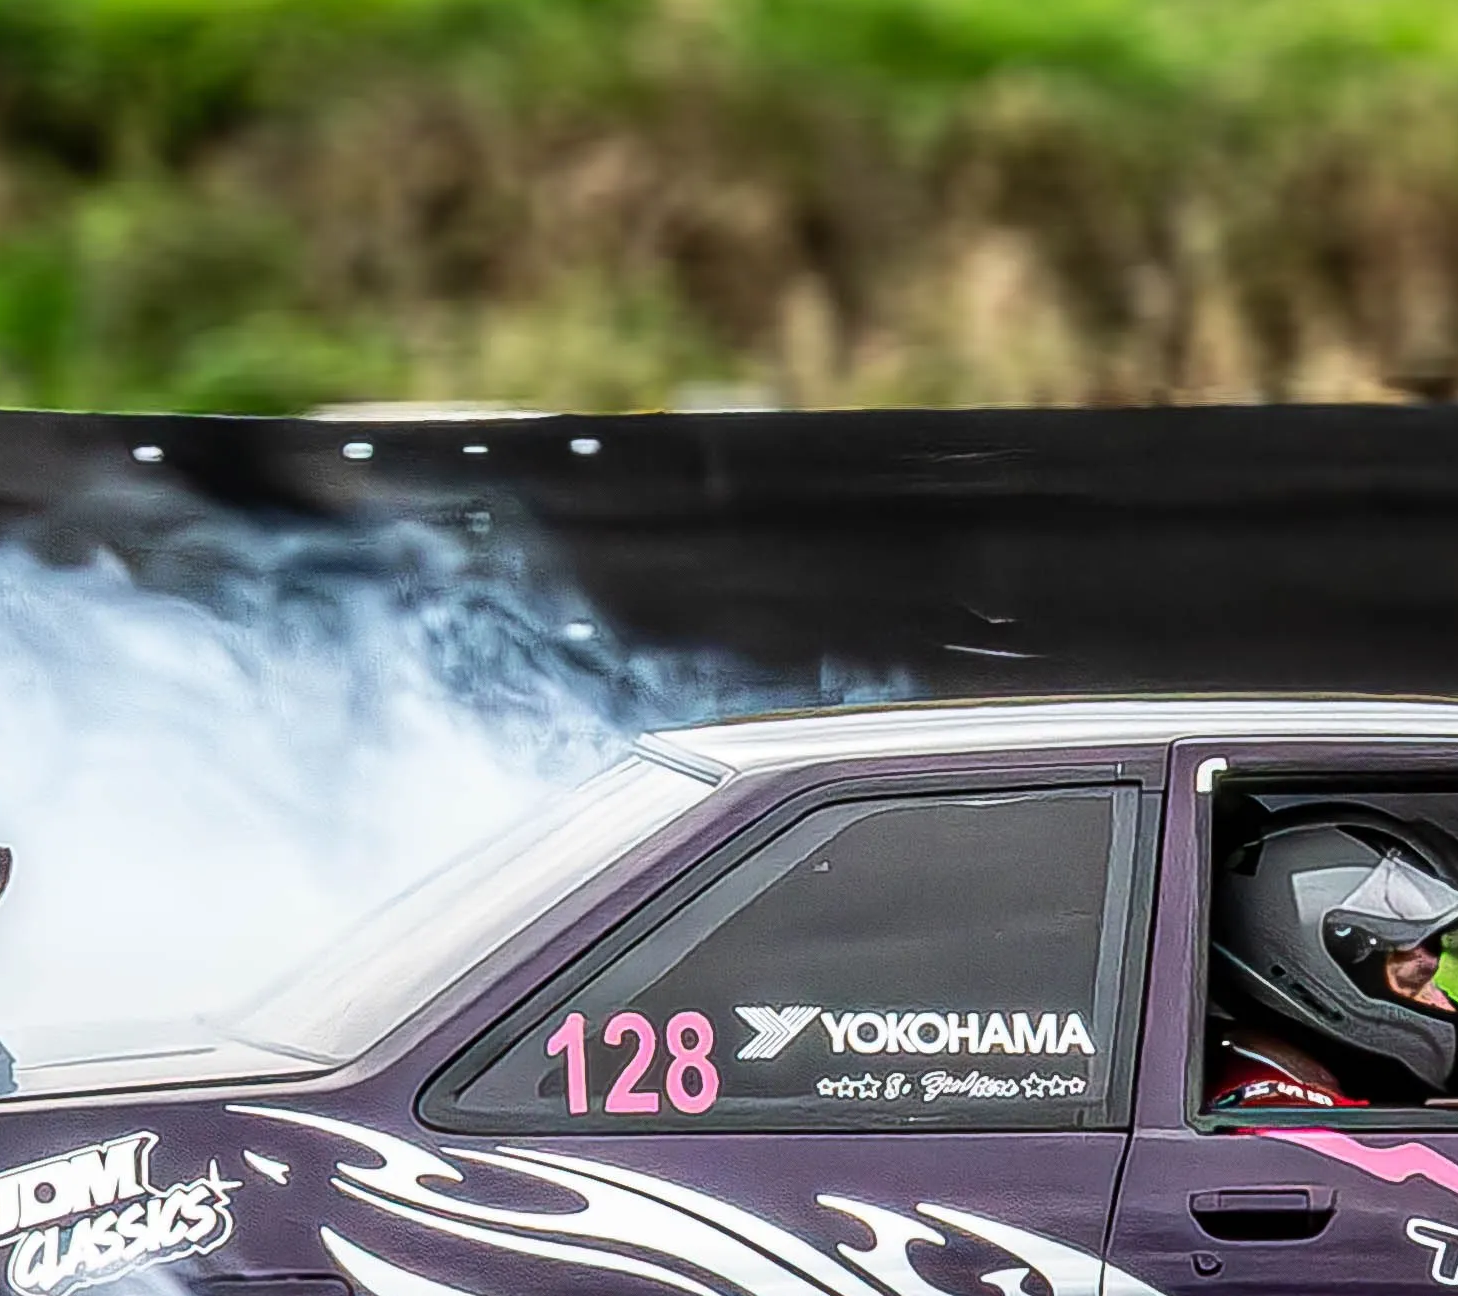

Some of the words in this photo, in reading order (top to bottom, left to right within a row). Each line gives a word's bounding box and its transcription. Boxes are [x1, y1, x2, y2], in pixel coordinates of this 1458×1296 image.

[546, 1010, 720, 1115] 128
[820, 1010, 1096, 1055] YOKOHAMA
[11, 1184, 218, 1291] CLASSICS
